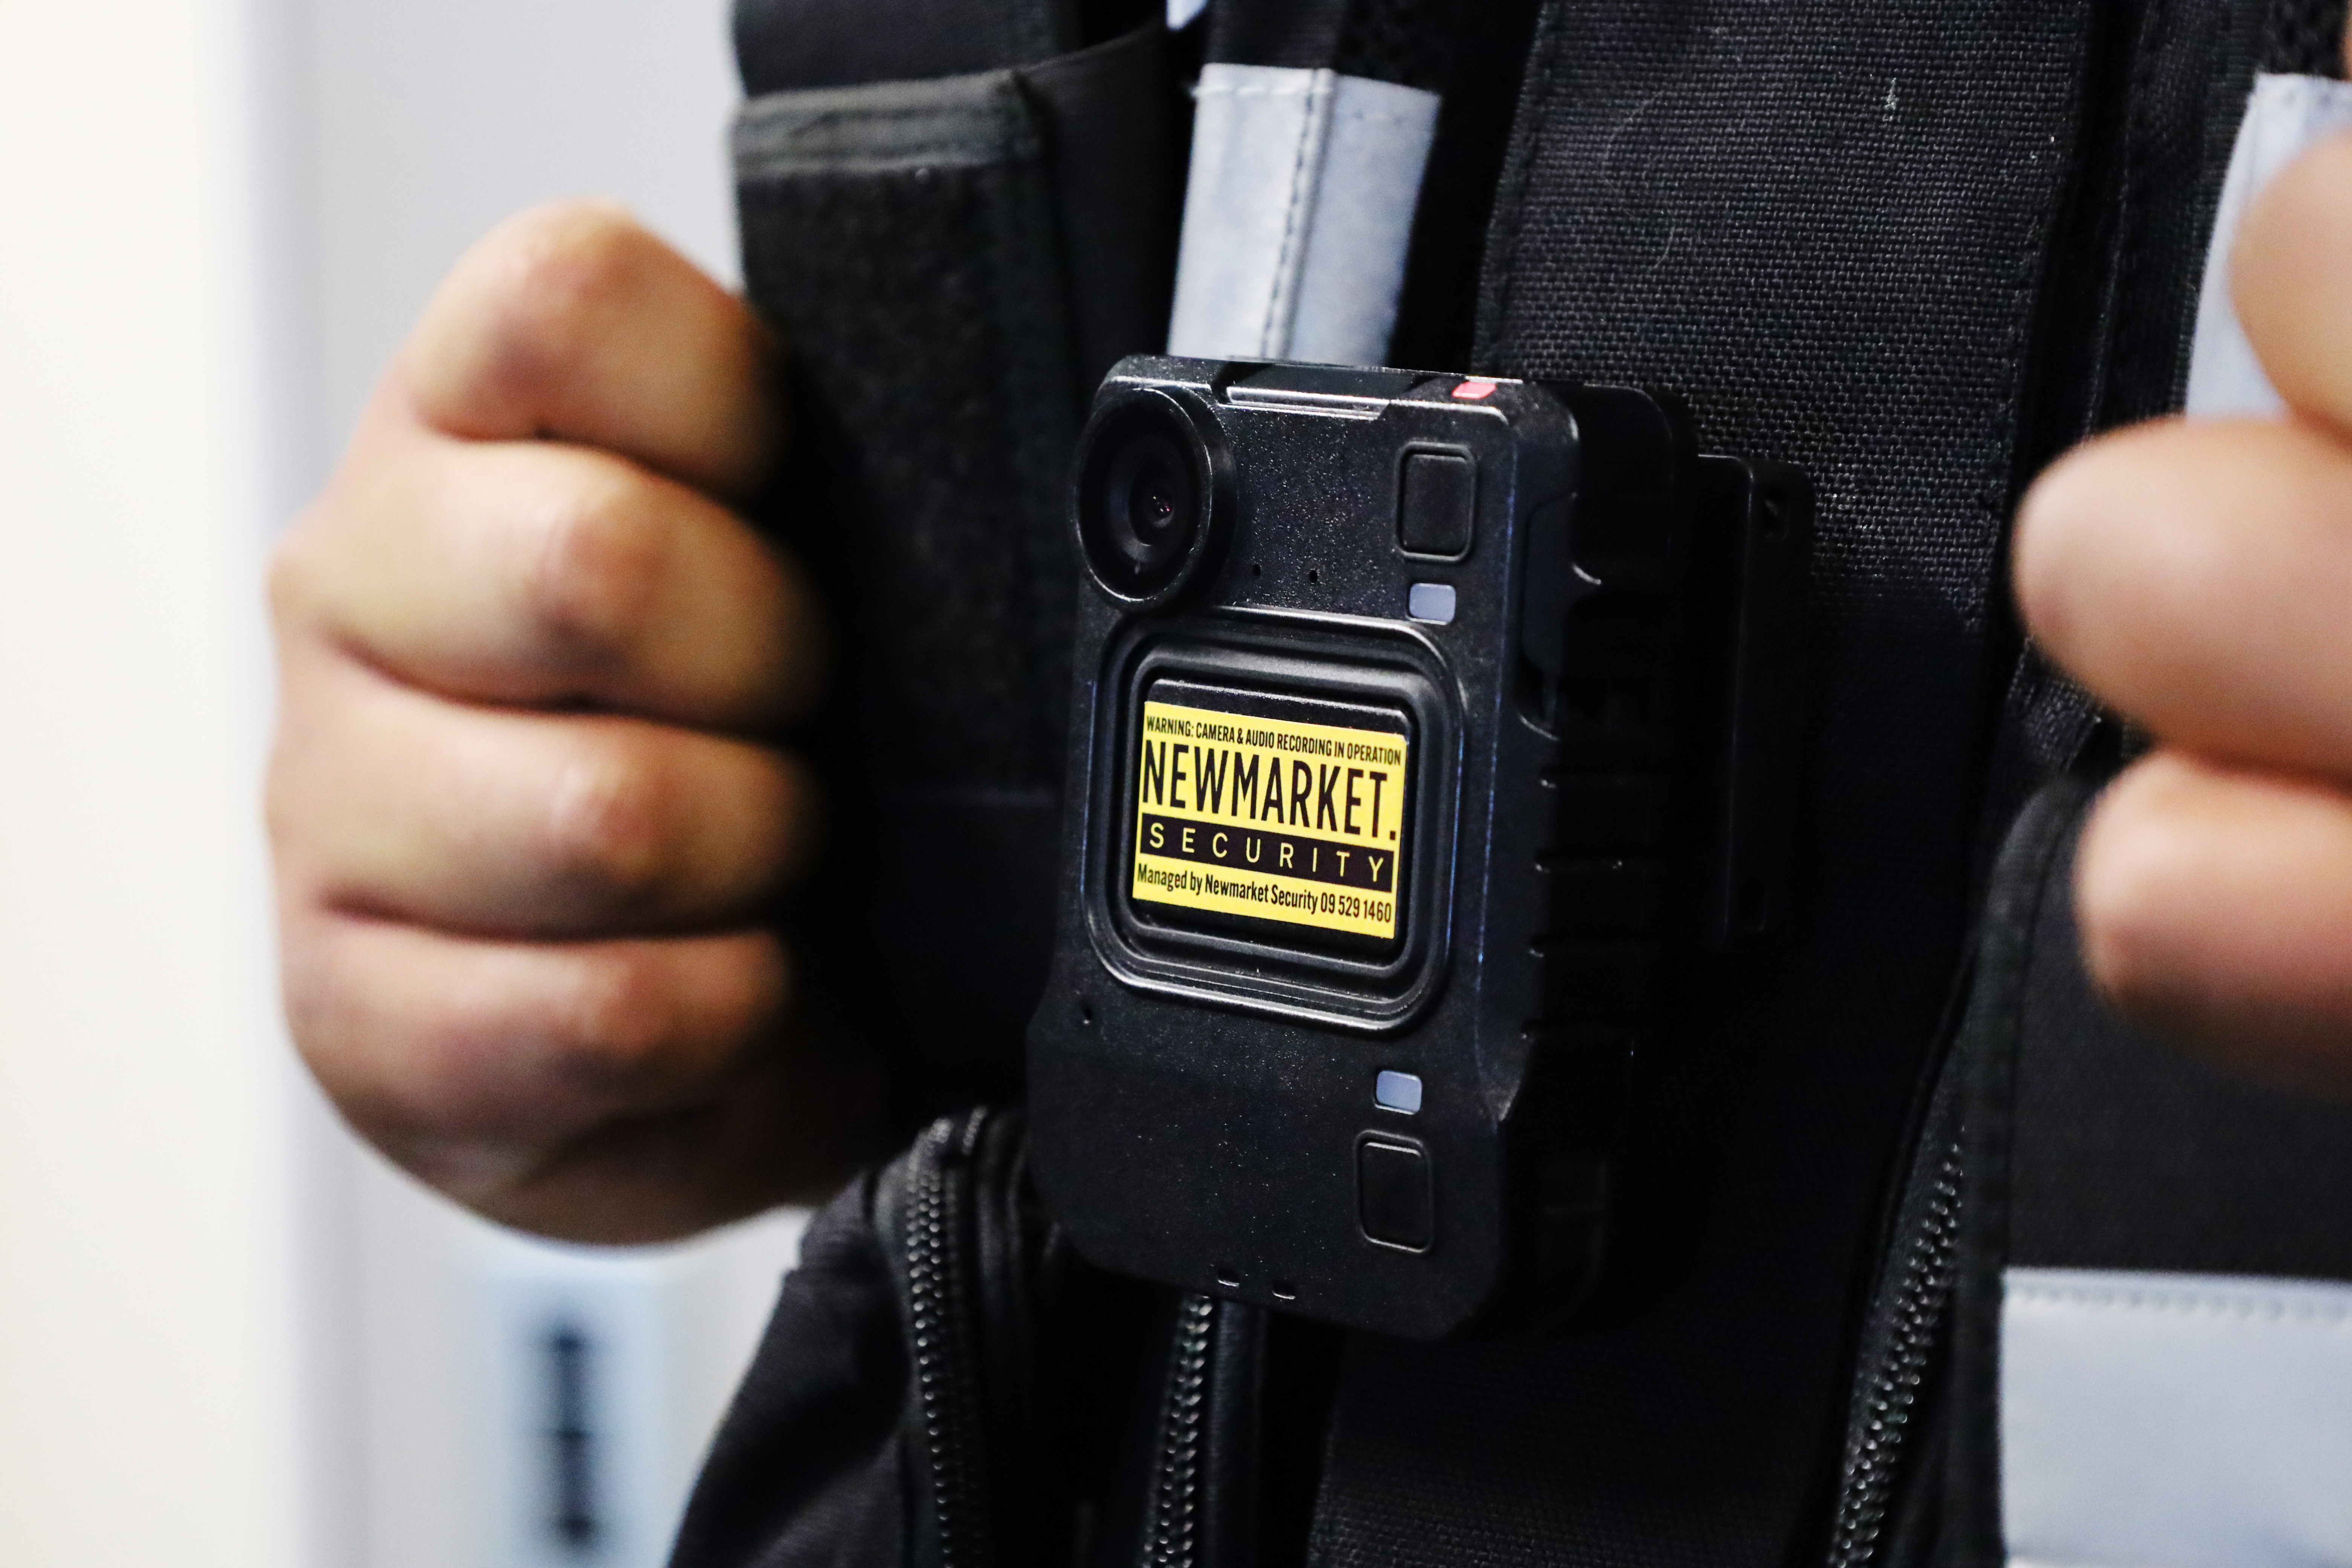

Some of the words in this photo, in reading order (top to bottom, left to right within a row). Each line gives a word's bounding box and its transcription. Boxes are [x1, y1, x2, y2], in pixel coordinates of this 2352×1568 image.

[1147, 715, 1194, 738] WARNING:
[1196, 722, 1235, 743] CAMERA
[1237, 727, 1244, 745] &
[1246, 729, 1275, 749] AUDIO
[1277, 733, 1332, 757] RECORDING
[1334, 741, 1344, 759] IN
[1347, 743, 1401, 766] OPERATION
[1142, 740, 1396, 840] NEWMARKET.
[1149, 822, 1384, 882] SECURITY
[1138, 863, 1187, 892] Managed
[1190, 871, 1203, 896] by
[1205, 874, 1269, 903] Newmarket
[1271, 884, 1318, 915] Security
[1320, 892, 1335, 914] 09
[1338, 895, 1360, 918] 529
[1363, 900, 1391, 923] 1460
